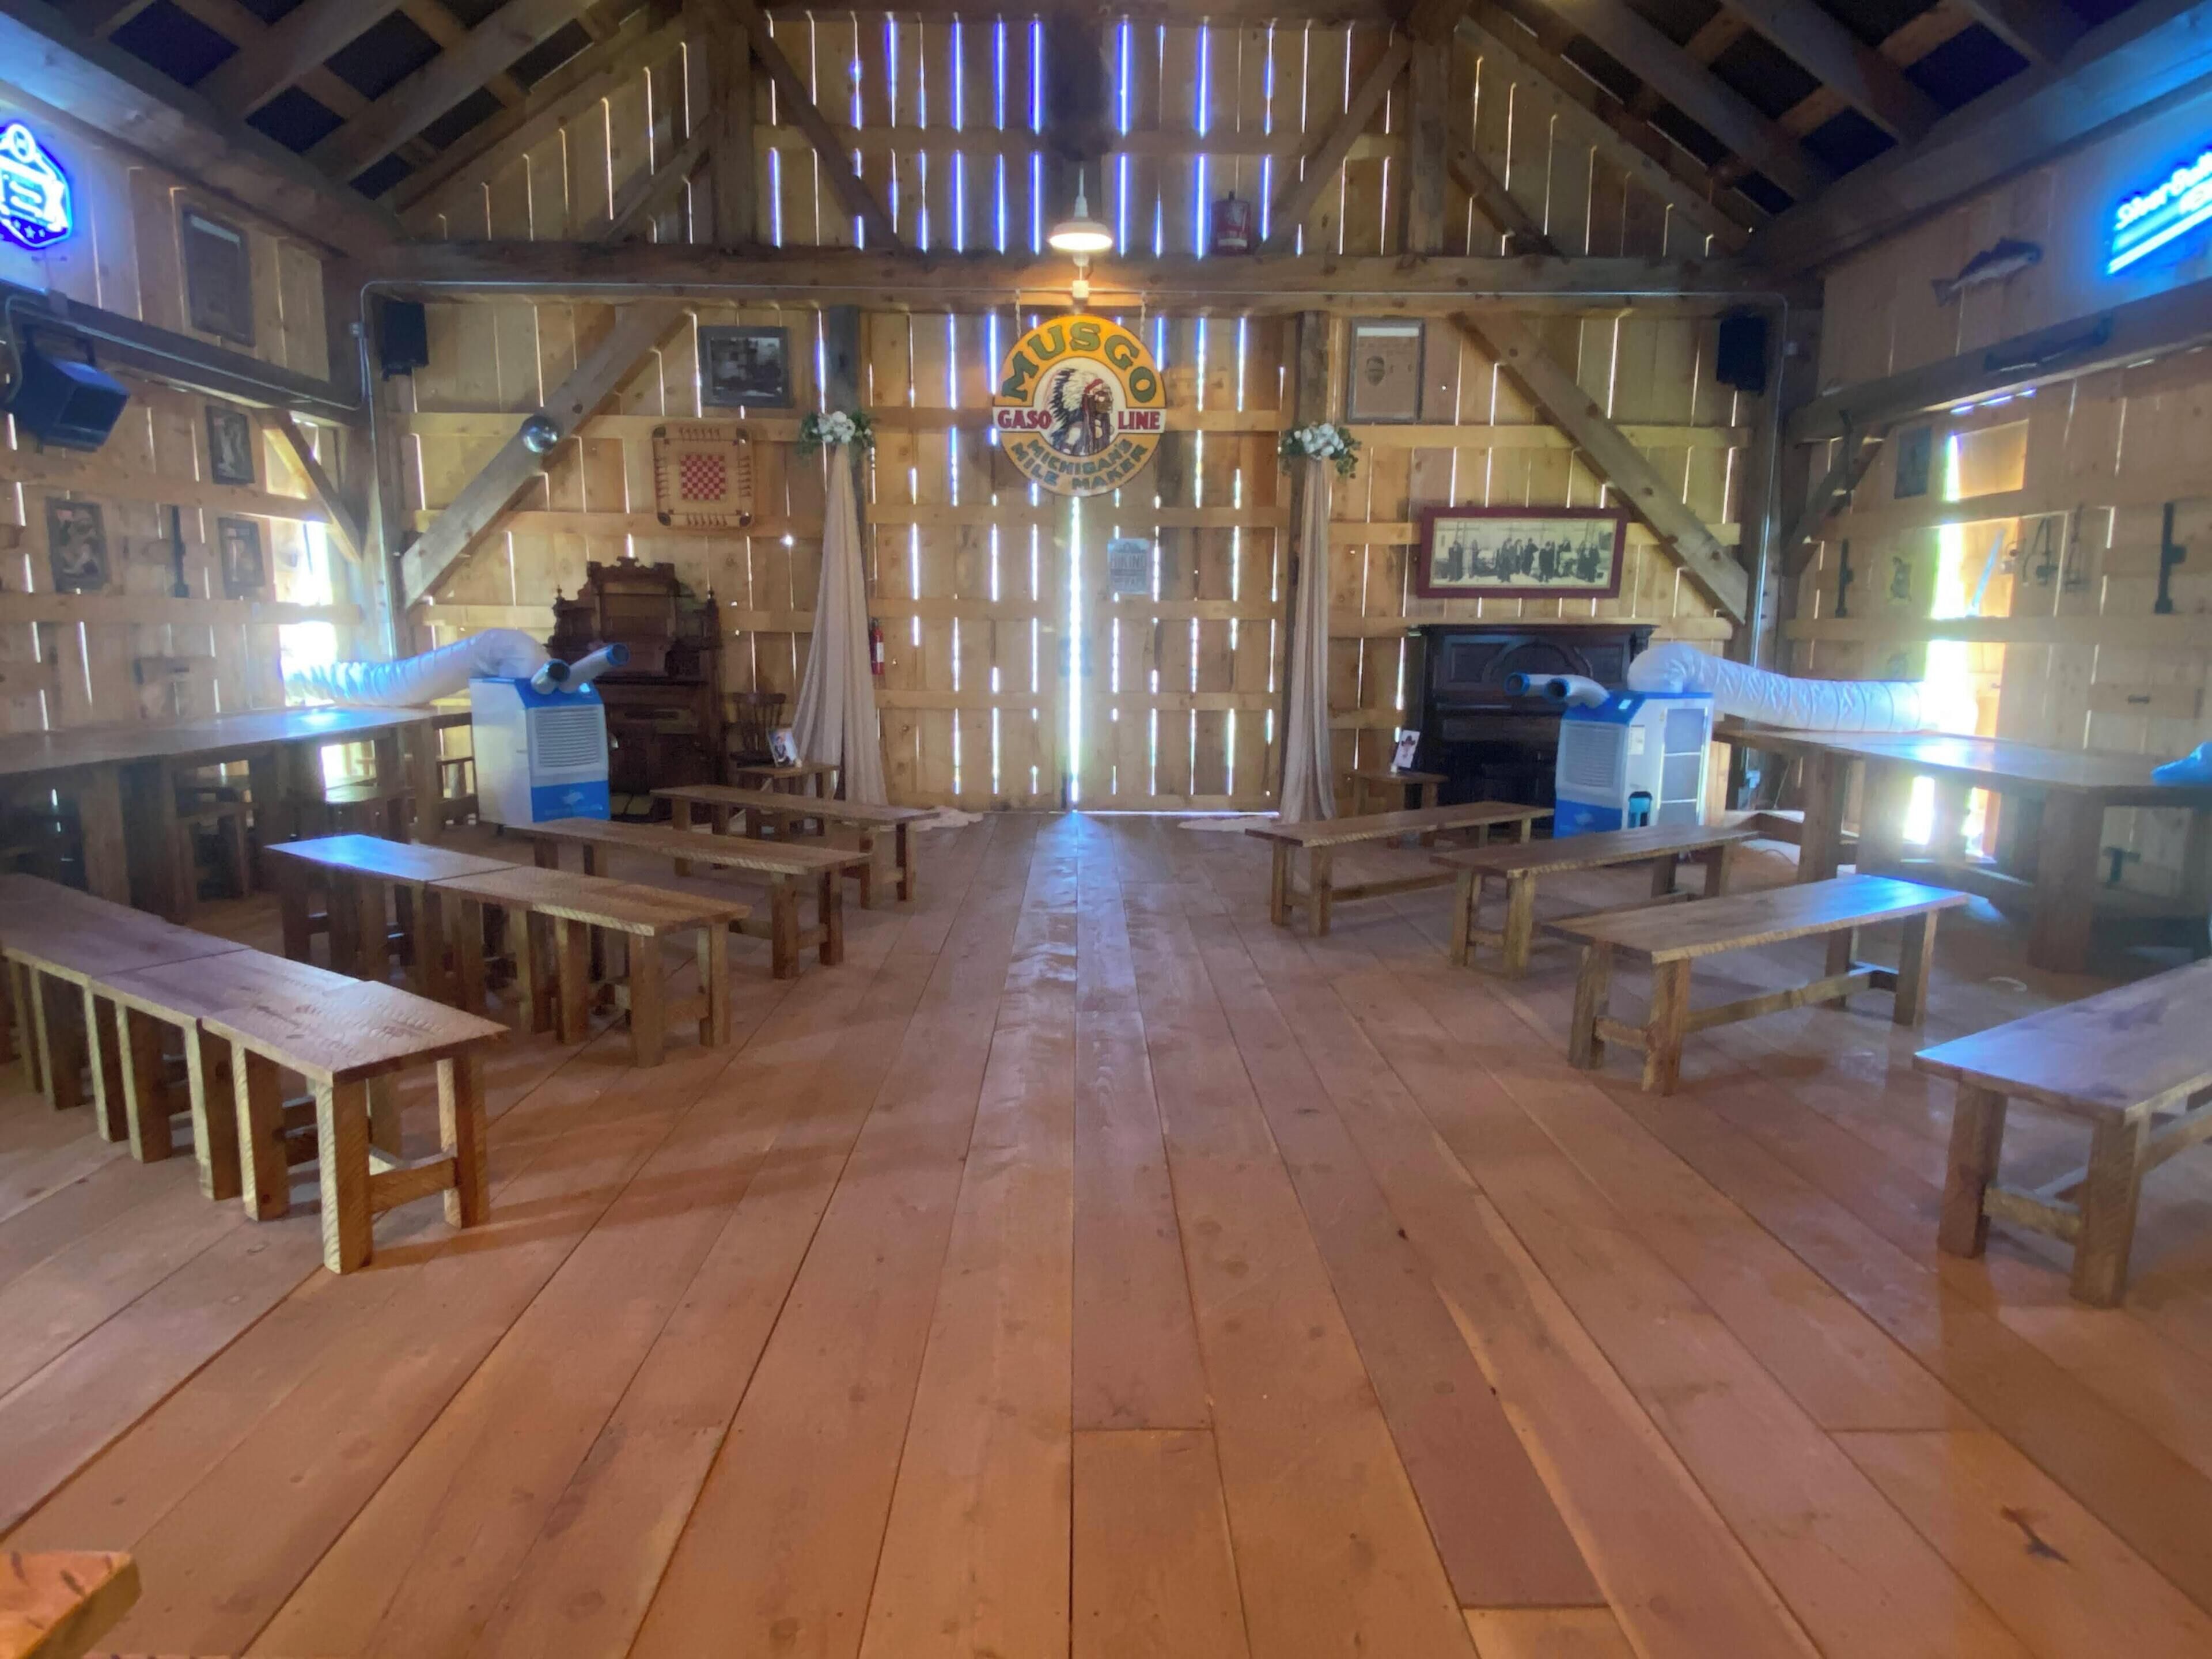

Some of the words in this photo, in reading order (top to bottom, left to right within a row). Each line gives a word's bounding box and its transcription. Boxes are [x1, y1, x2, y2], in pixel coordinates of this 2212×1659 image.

[1002, 322, 1156, 403] MUSGO
[998, 410, 1052, 429] GASO
[1118, 411, 1160, 430] LINE
[1011, 442, 1059, 486] MILE
[1072, 444, 1149, 489] MAKER
